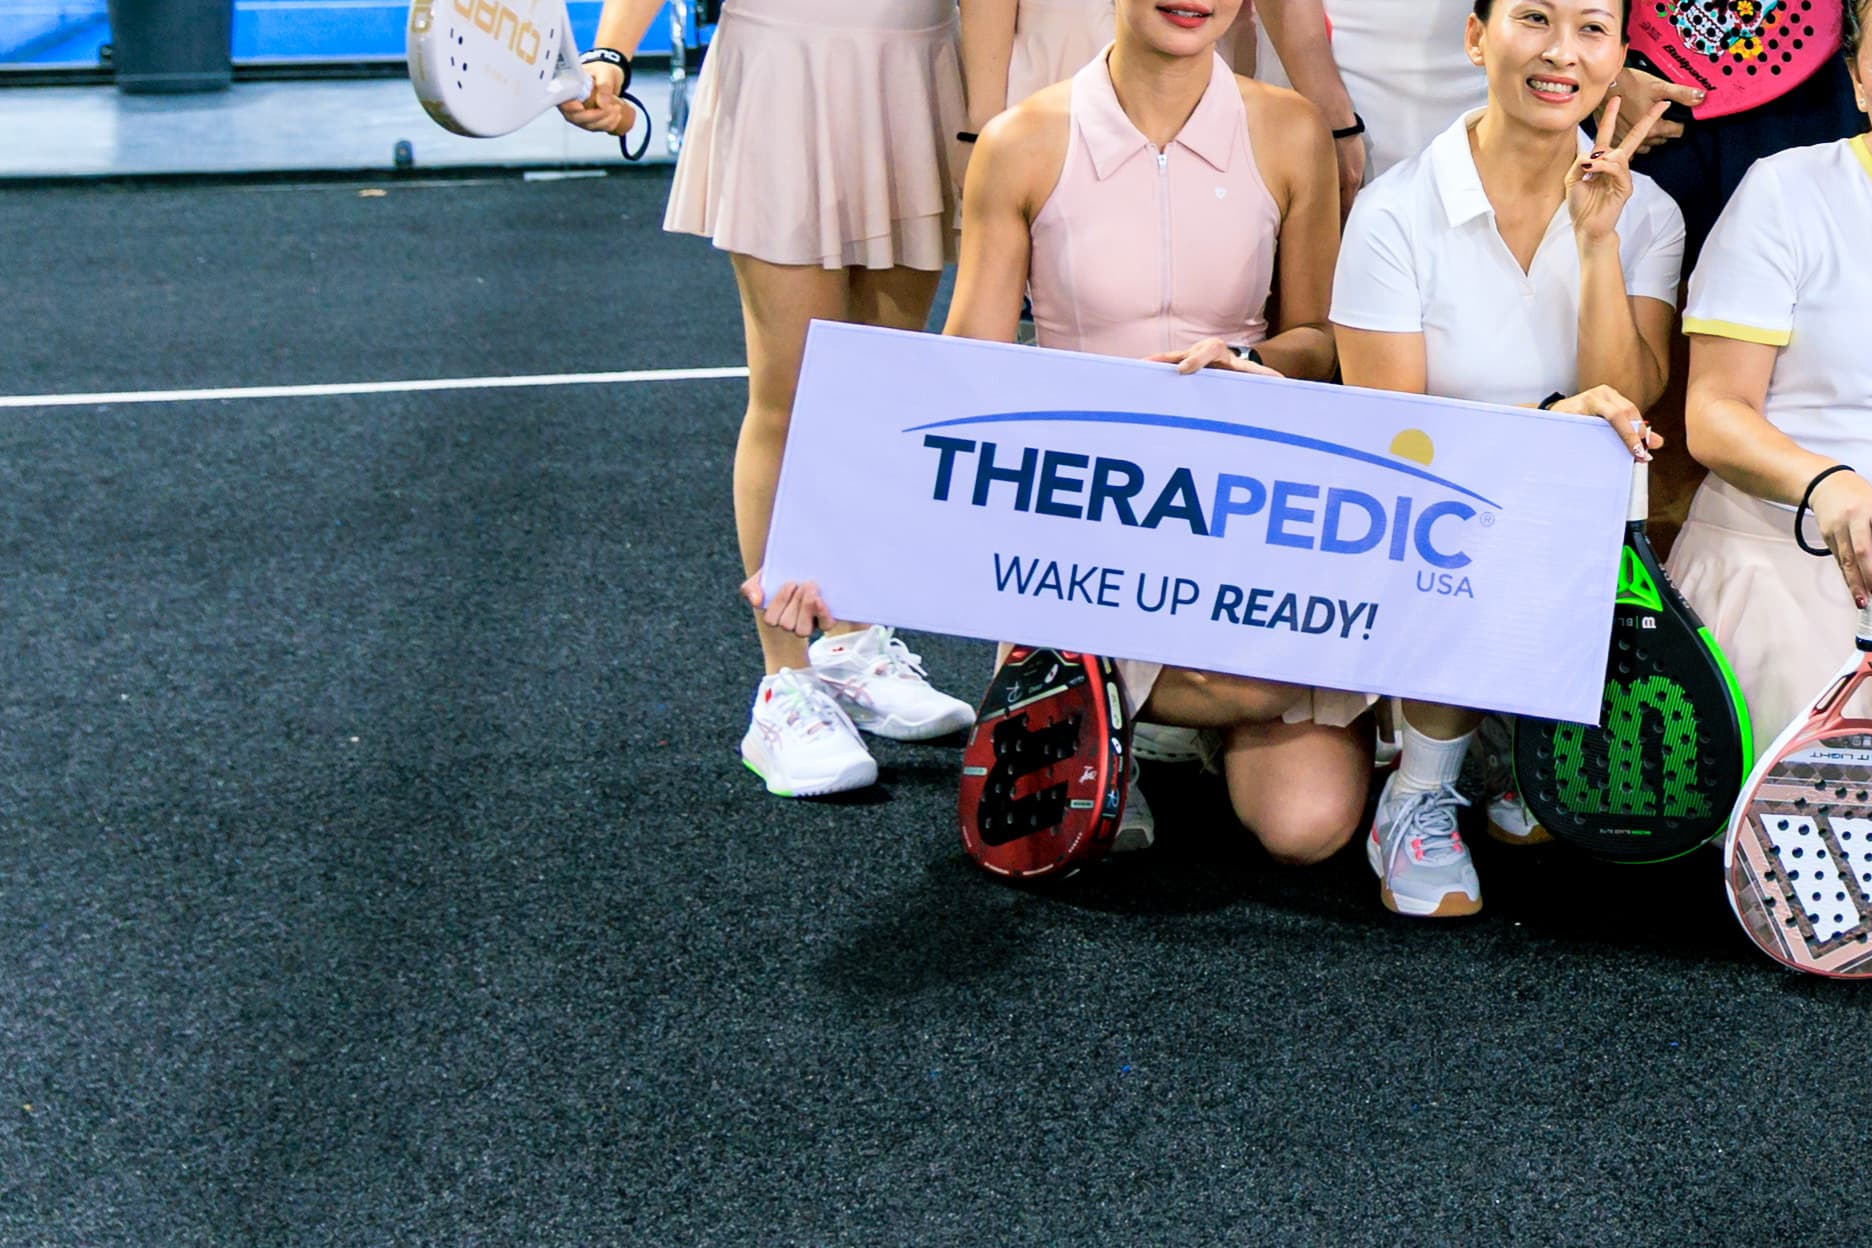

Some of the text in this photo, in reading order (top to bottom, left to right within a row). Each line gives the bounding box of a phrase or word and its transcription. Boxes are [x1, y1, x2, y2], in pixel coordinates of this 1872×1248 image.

[923, 434, 1477, 570] THERAPEDIC
[993, 553, 1379, 641] WAKE UP READY!
[1416, 570, 1474, 599] USA
